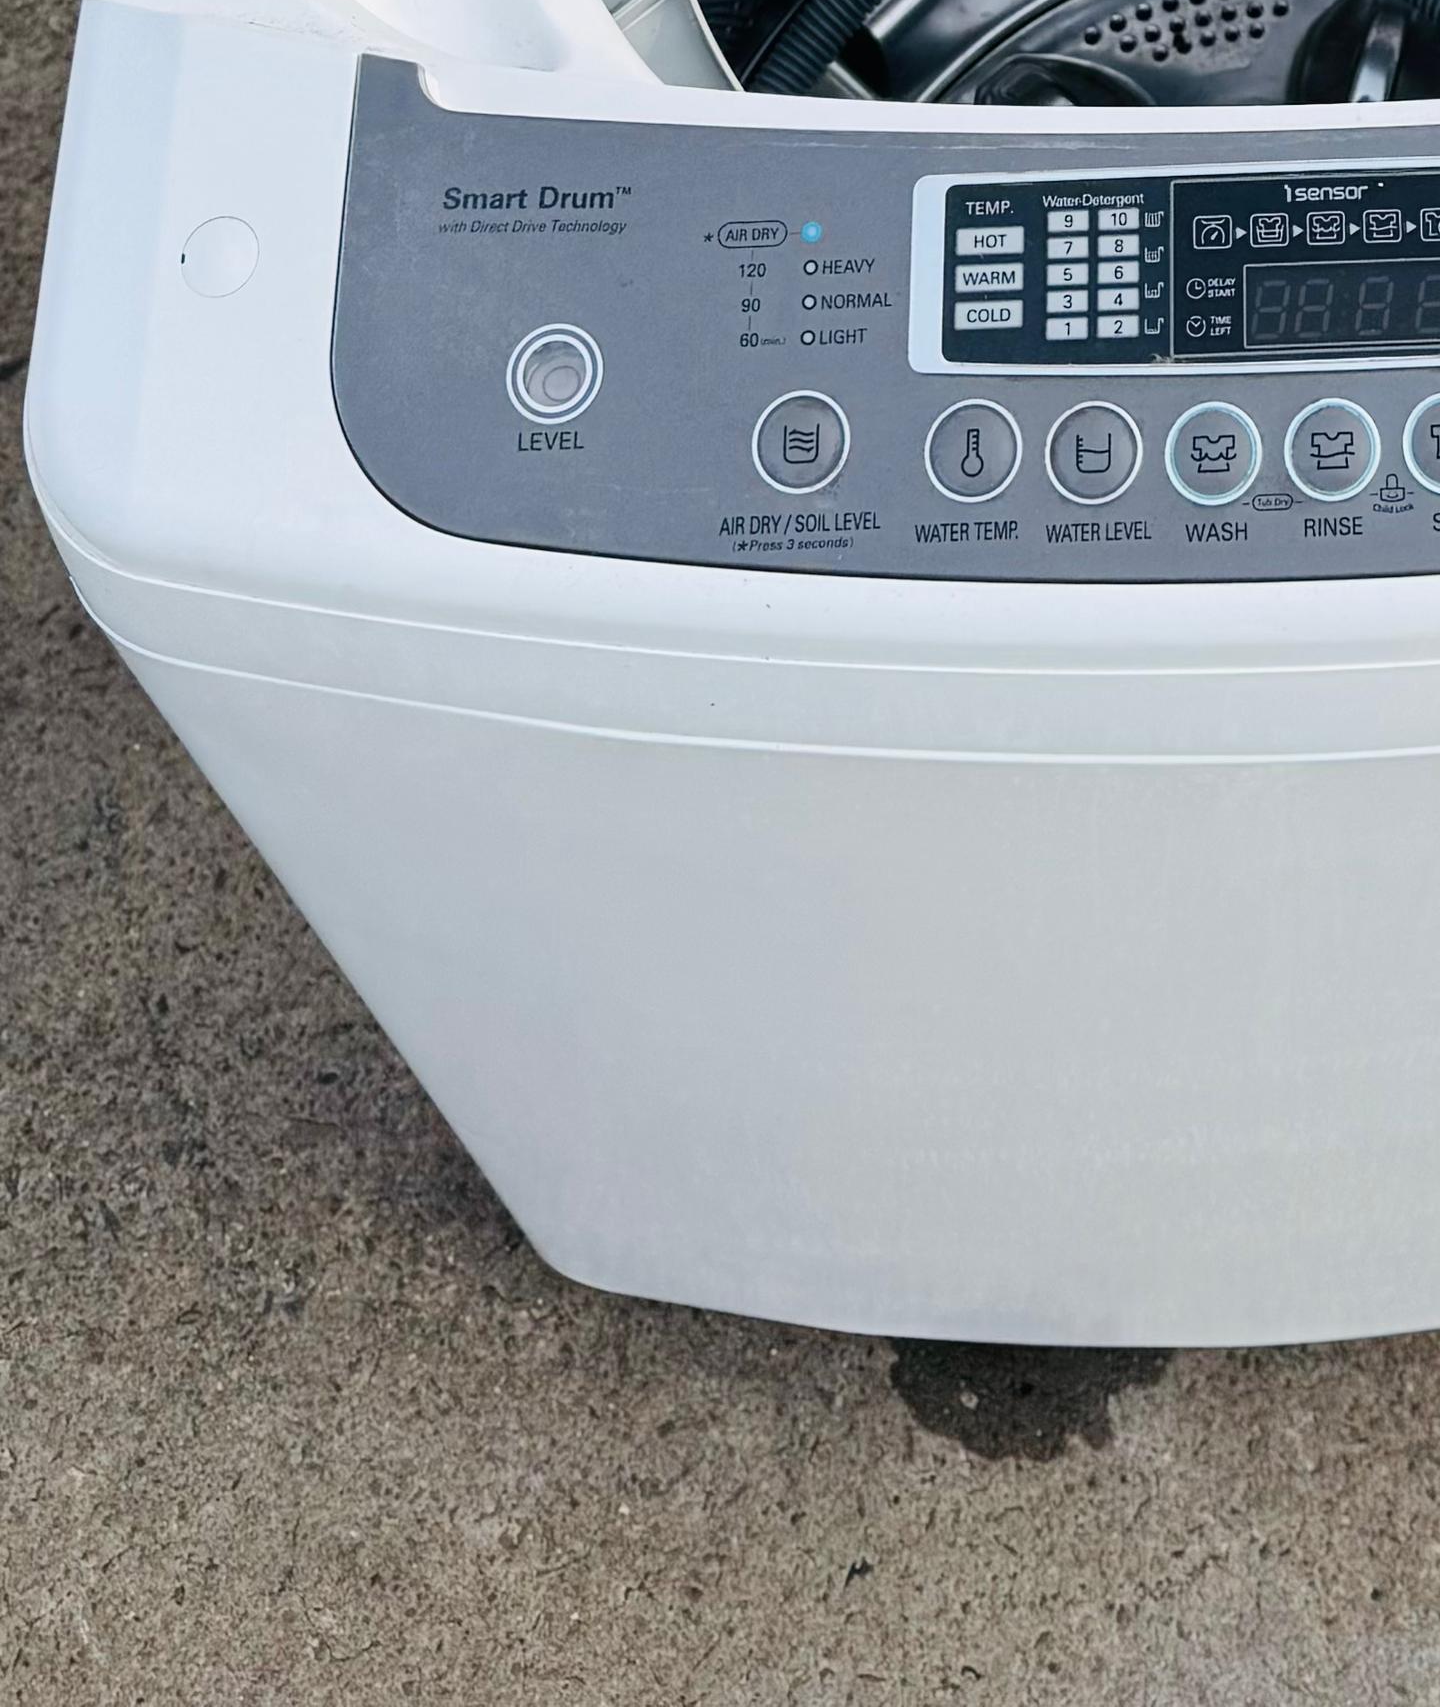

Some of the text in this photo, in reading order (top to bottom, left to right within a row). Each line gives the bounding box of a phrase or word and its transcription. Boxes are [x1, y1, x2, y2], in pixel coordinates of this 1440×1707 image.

[443, 187, 528, 209] Smart
[965, 201, 1014, 215] TEMP.
[1064, 214, 1073, 227] 9
[1111, 212, 1127, 226] 10
[439, 219, 628, 235] with Direct Drive Technology
[725, 227, 780, 242] AIR DRY
[974, 234, 1007, 248] HOT
[1064, 242, 1073, 254] 7
[1114, 239, 1124, 253] 8
[738, 263, 767, 278] 120
[822, 258, 876, 274] HEAVY
[1114, 266, 1124, 280] 6
[963, 271, 1016, 286] WARM
[1063, 268, 1073, 281] 5
[1208, 278, 1236, 288] DELAY
[1113, 293, 1123, 306] 4
[1207, 288, 1236, 298] START
[741, 298, 761, 313] 90
[821, 292, 892, 309] NORMAL
[1063, 295, 1073, 309] 3
[966, 308, 1011, 323] COLD
[1210, 316, 1232, 325] TIME
[1065, 323, 1071, 336] 1
[1113, 321, 1123, 334] 2
[1210, 326, 1232, 336] LEFT
[739, 333, 759, 347] 60
[819, 328, 868, 345] LIGHT
[518, 431, 584, 452] LEVEL
[1373, 502, 1394, 514] Child
[719, 515, 745, 536] AIR
[750, 514, 783, 535] DRY
[795, 512, 830, 532] SOIL
[835, 511, 881, 531] LEVEL
[1304, 516, 1364, 537] RINSE
[914, 520, 1019, 542] WATER TEMP.
[1045, 520, 1152, 543] WATER LEVEL
[1185, 522, 1248, 542] WASH
[786, 538, 795, 550] 3
